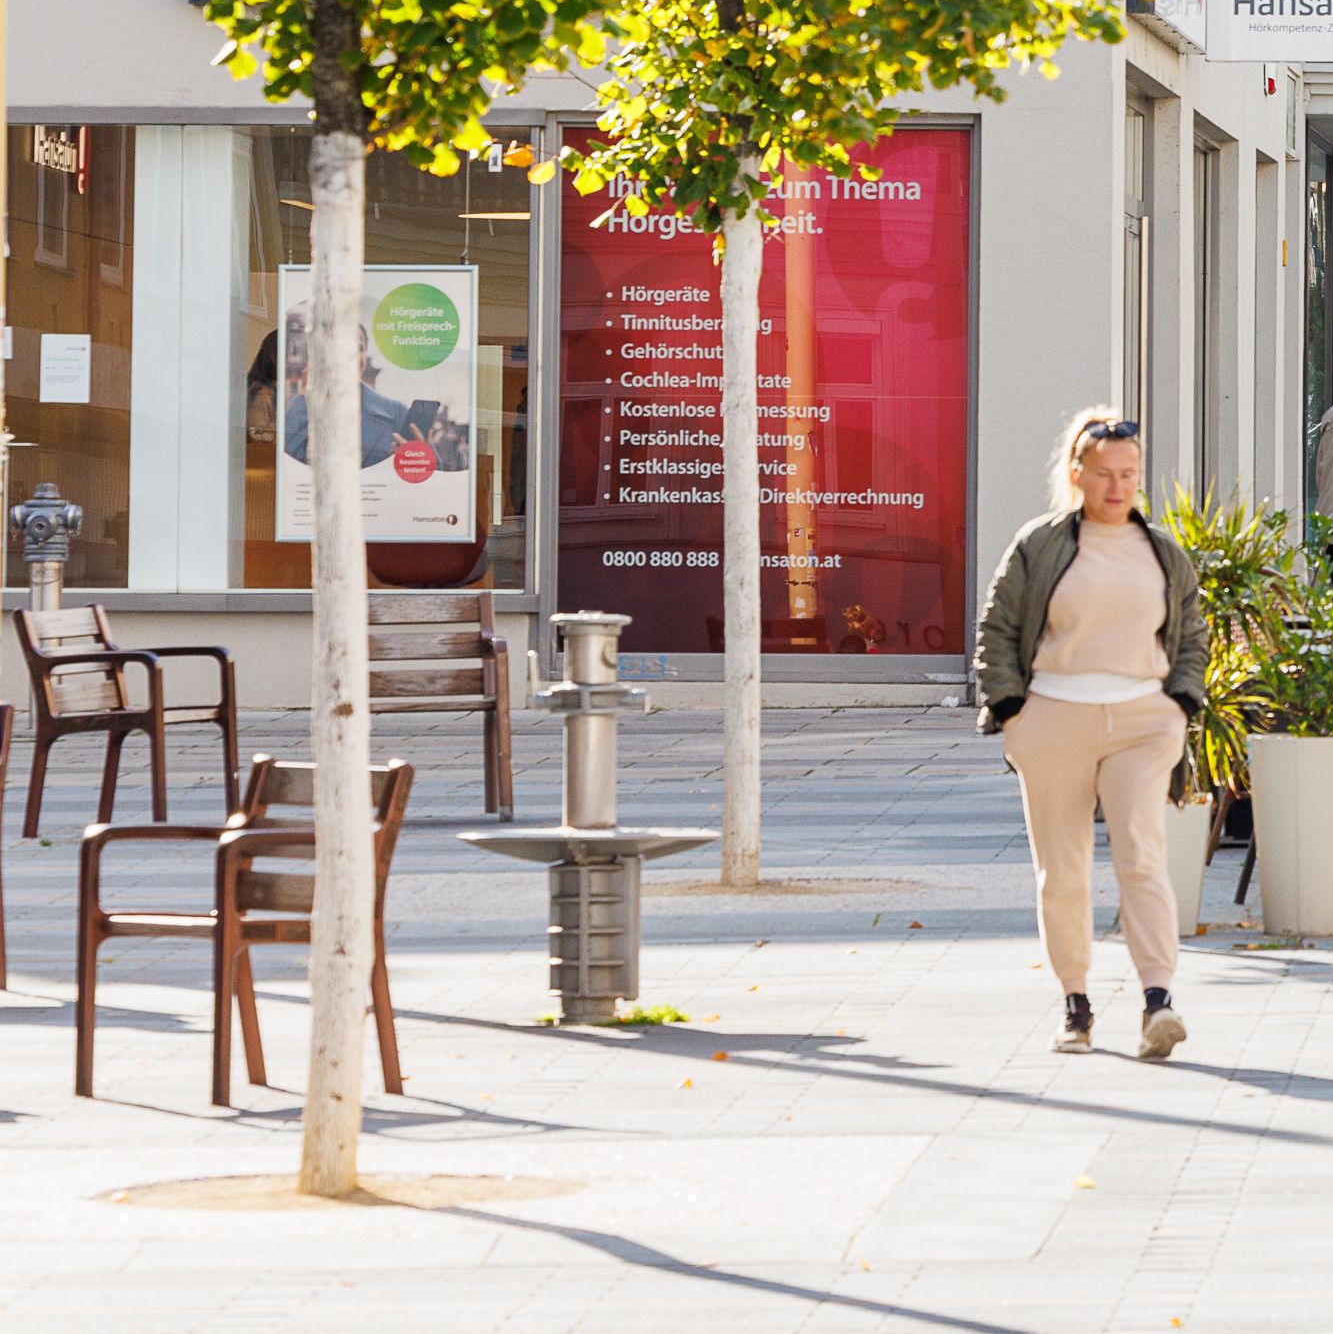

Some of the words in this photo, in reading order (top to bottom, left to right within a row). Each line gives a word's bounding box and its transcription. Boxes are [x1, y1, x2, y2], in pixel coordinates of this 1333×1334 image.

[826, 176, 921, 200] Thema
[621, 285, 710, 306] Hörgeräte
[620, 343, 724, 360] Gehörschut
[620, 400, 715, 418] Kostenlose
[602, 551, 646, 566] 0800
[650, 551, 682, 566] 880
[686, 552, 719, 567] 888
